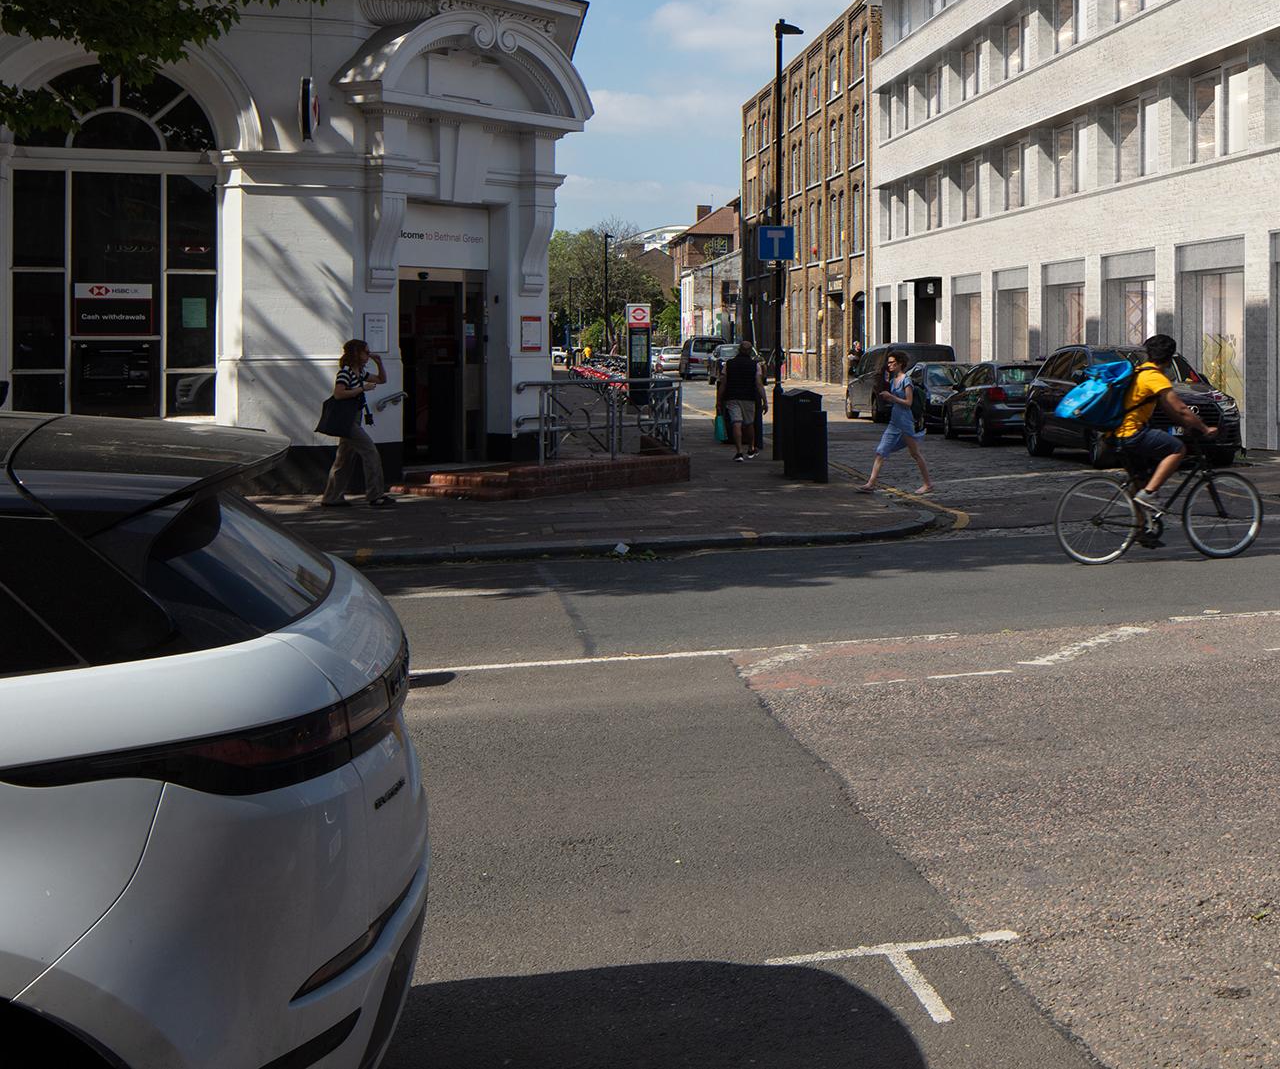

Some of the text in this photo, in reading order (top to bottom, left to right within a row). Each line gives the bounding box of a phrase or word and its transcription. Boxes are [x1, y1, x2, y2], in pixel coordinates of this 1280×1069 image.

[399, 230, 425, 240] lcome
[434, 232, 461, 242] Bethnal
[462, 234, 484, 244] Green
[81, 313, 146, 321] Cash withdrawals
